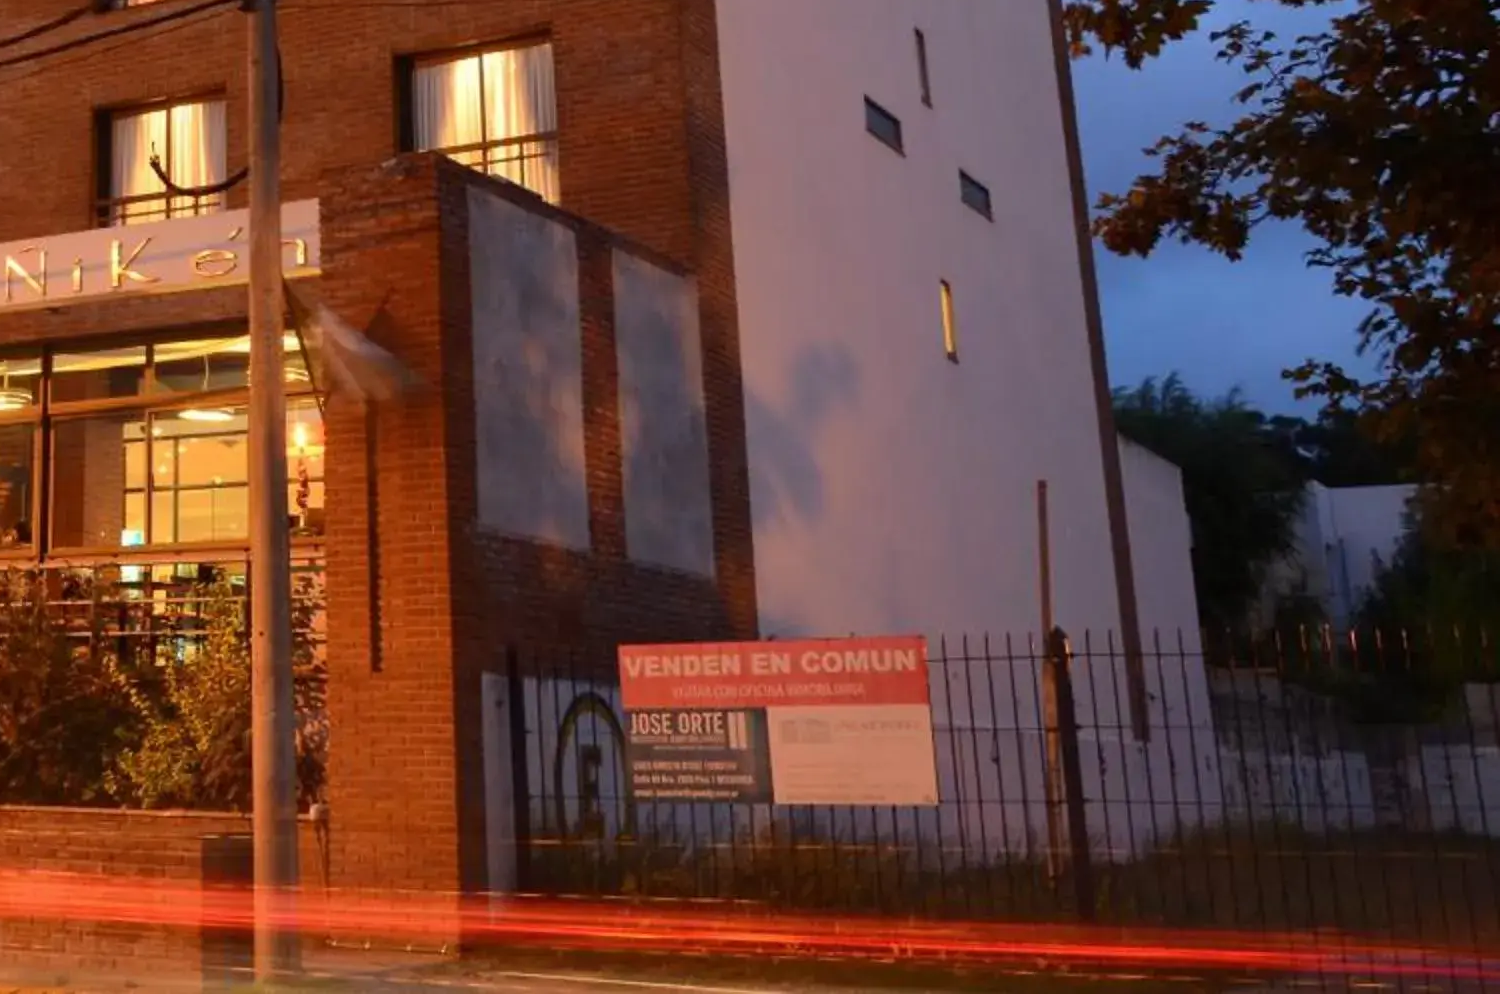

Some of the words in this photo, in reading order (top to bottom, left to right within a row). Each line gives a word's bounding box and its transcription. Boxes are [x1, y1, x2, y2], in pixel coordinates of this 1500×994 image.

[625, 655, 741, 679] VENDEN
[751, 652, 791, 675] EN
[802, 648, 917, 673] COMUN
[630, 712, 673, 735] JOSE
